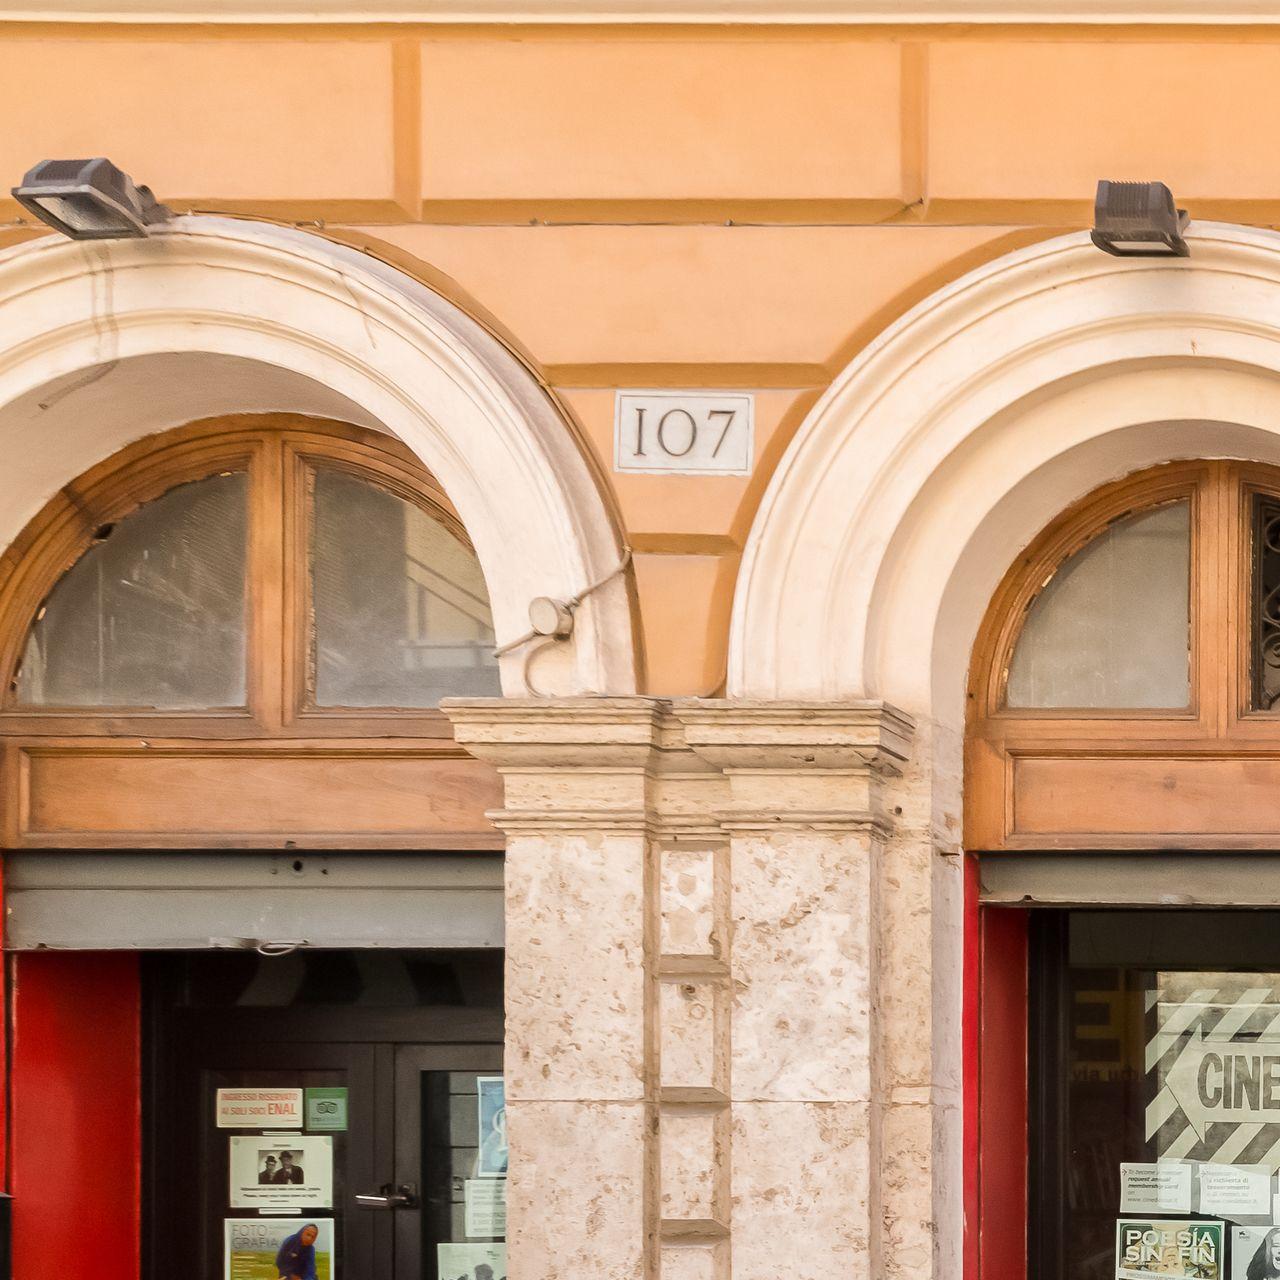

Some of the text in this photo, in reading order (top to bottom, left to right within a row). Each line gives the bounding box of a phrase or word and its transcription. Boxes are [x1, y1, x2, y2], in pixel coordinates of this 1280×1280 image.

[632, 407, 737, 459] 107
[267, 1103, 297, 1115] ENAL
[231, 1224, 267, 1237] FOTO
[1125, 1245, 1216, 1264] SIN FIN
